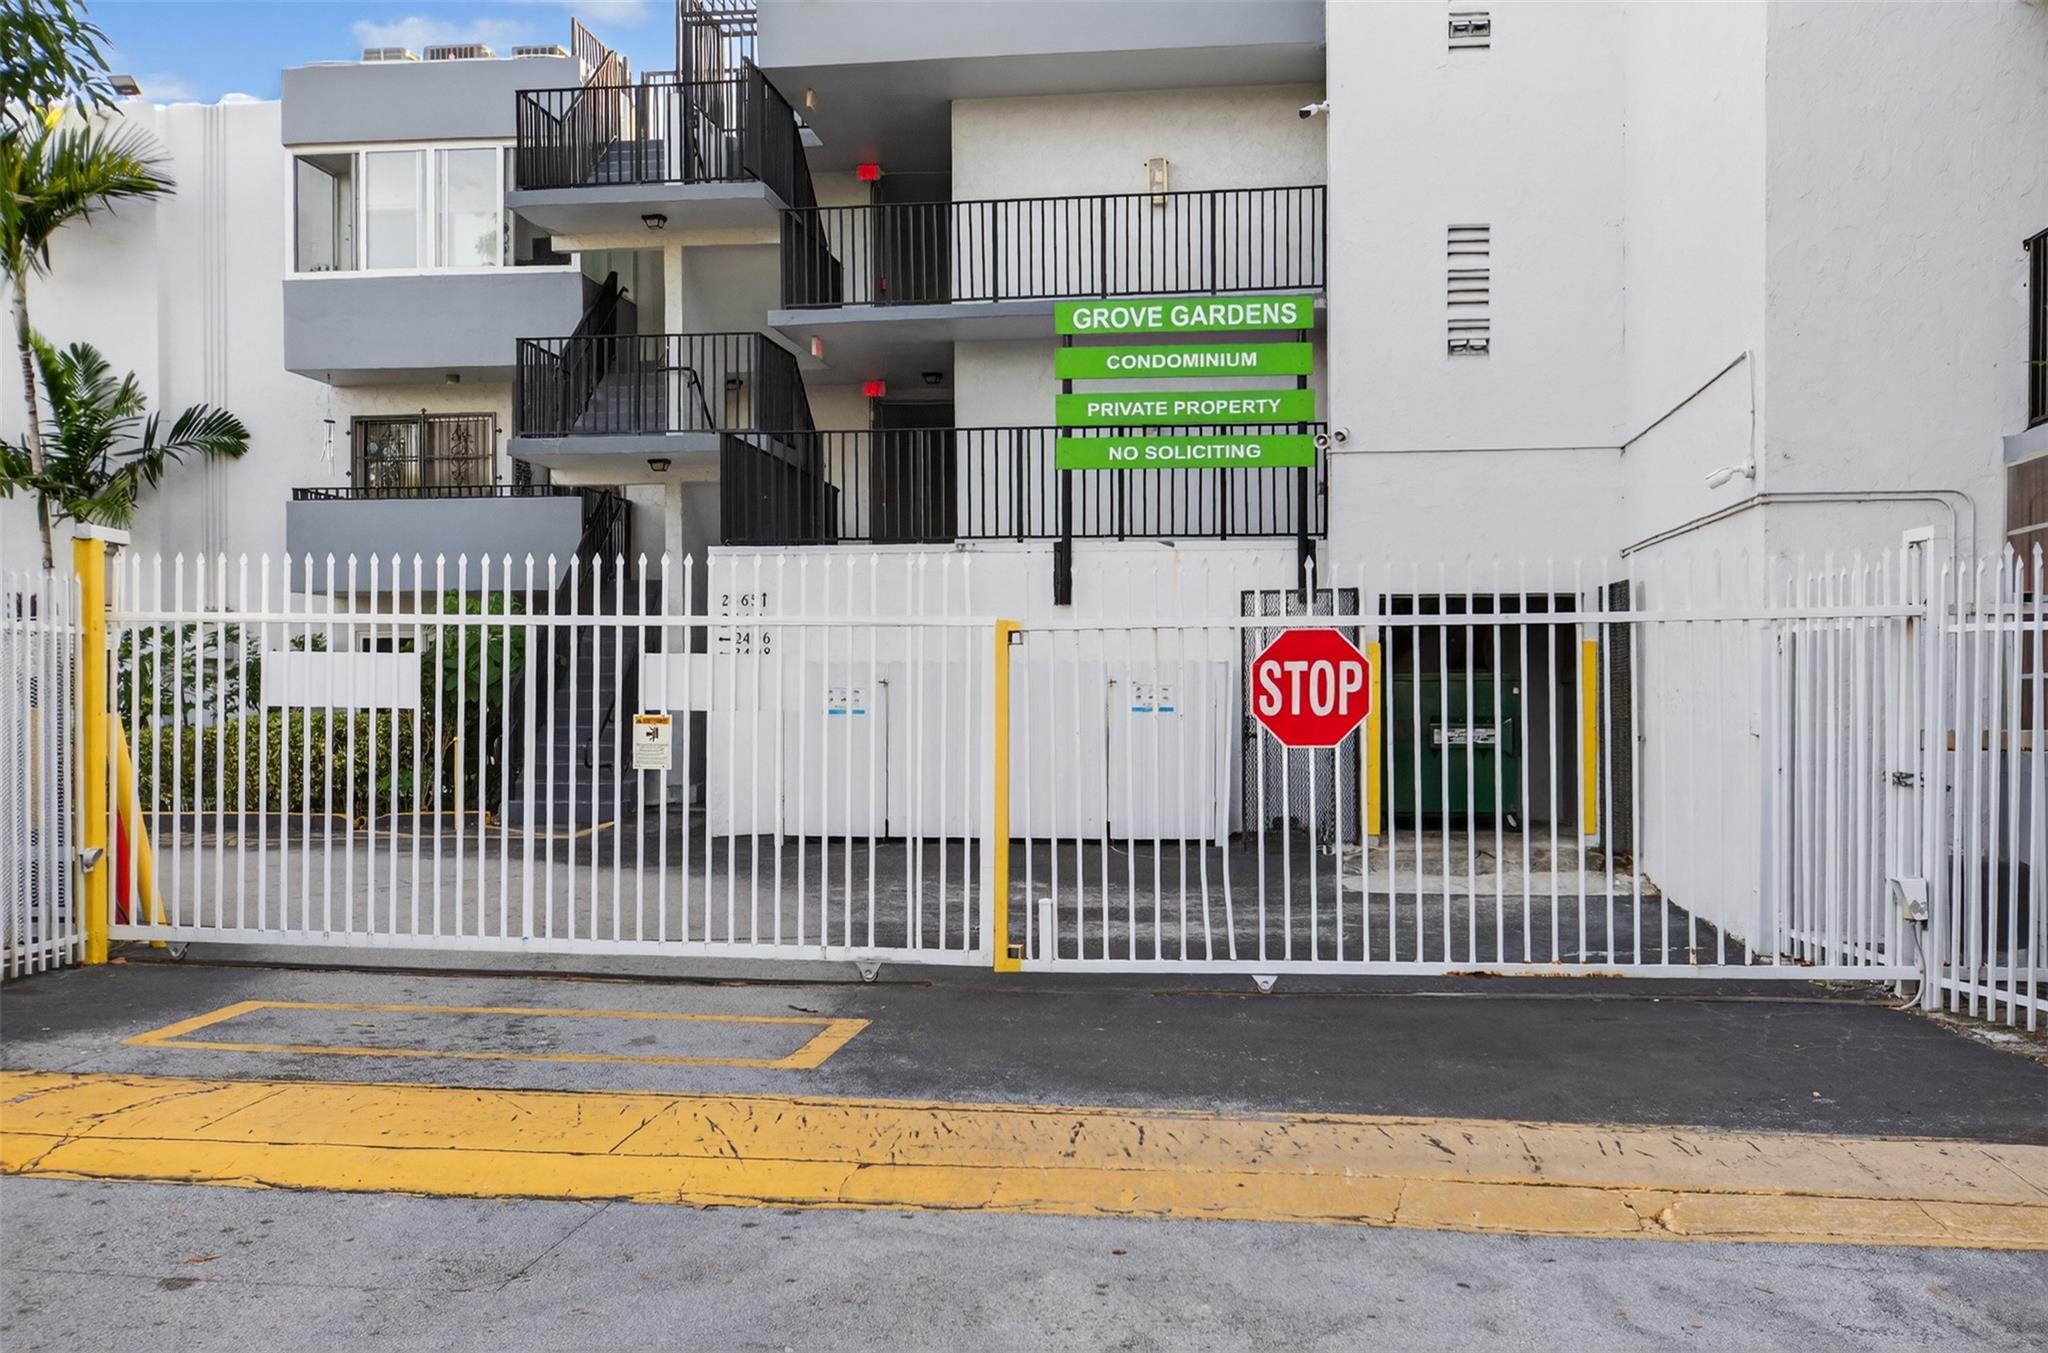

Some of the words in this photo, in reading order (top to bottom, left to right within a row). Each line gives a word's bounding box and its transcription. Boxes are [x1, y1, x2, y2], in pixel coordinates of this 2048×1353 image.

[1072, 306, 1163, 329] GROVE
[1170, 302, 1298, 327] GARDENS
[1106, 352, 1257, 370] CONDOMINIUM
[1087, 401, 1168, 417] PRIVATE
[1174, 398, 1281, 415] PROPERTY
[1109, 446, 1139, 461] NO
[1145, 444, 1261, 460] SOLICITING
[1259, 659, 1363, 717] STOP
